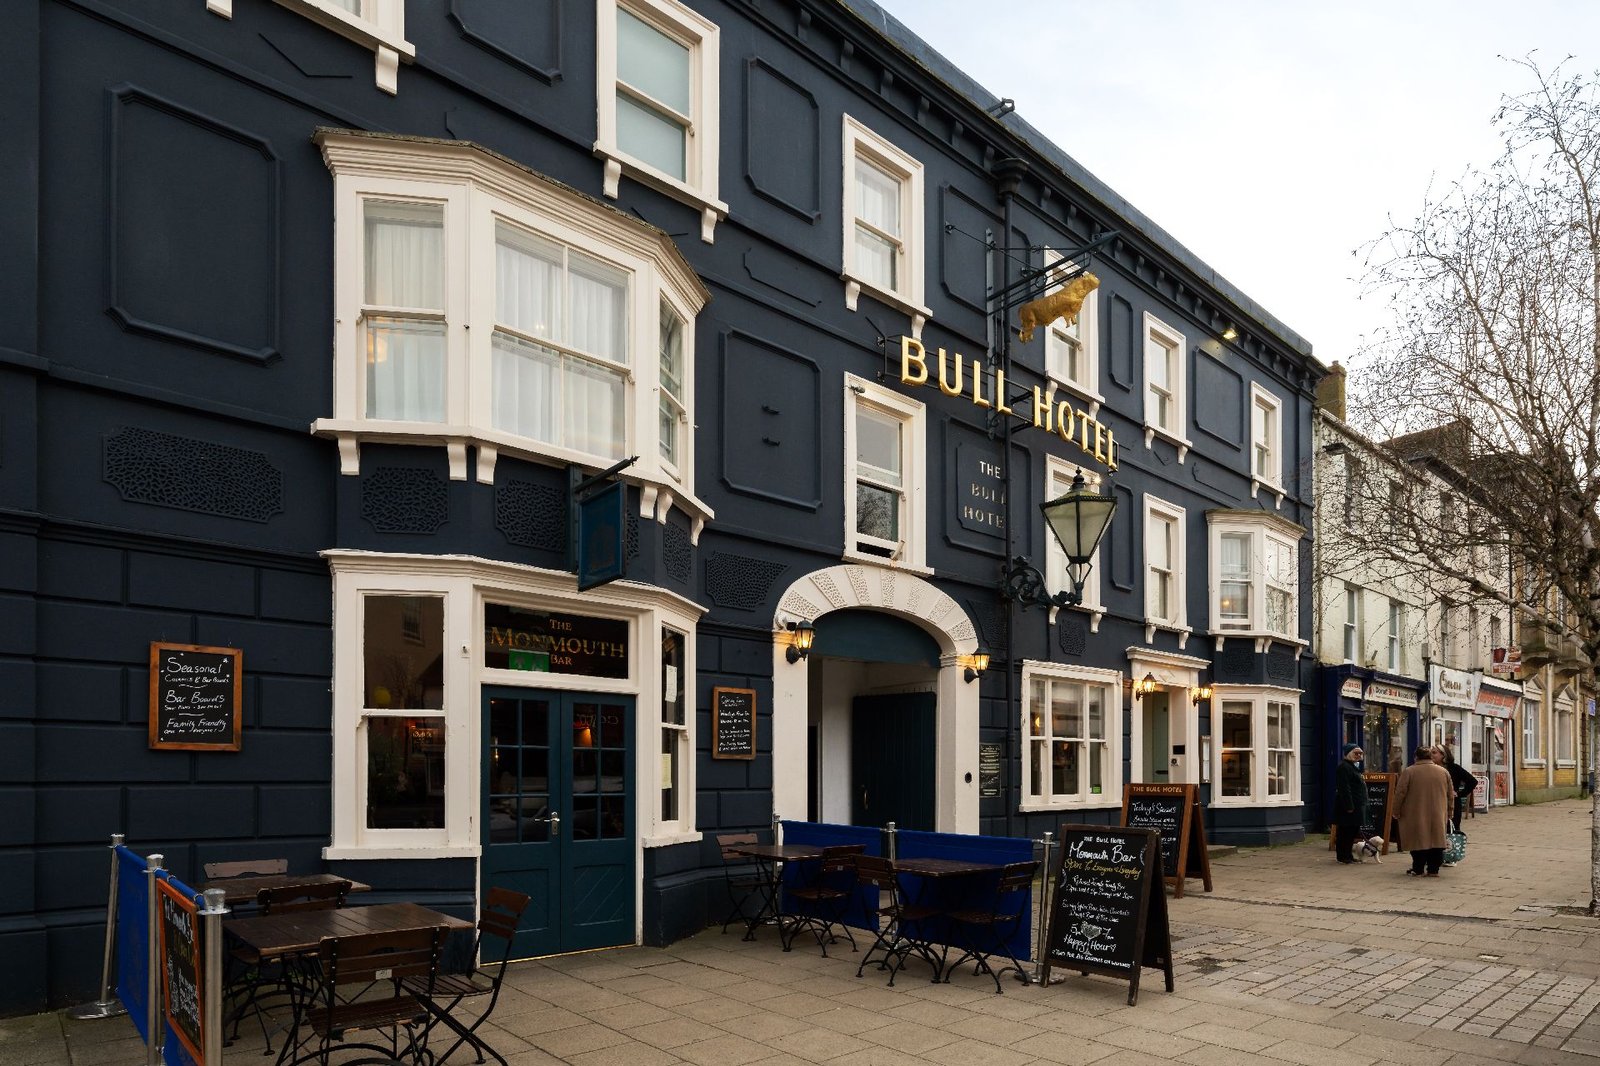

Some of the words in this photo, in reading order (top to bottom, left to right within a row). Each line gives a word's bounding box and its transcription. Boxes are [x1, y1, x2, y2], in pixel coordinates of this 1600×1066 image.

[902, 335, 1012, 415] BULL
[1033, 385, 1118, 472] HOTEL
[979, 460, 1001, 479] THE
[964, 505, 1005, 528] HOTE
[549, 619, 572, 631] THE
[490, 626, 625, 658] MONMOUTH
[167, 656, 222, 674] Seasonal
[550, 654, 572, 666] BAR
[166, 689, 187, 703] Bar
[191, 691, 225, 704] Boards
[167, 718, 195, 732] Family
[198, 718, 227, 732] Friendly
[1111, 845, 1136, 864] Bar
[1064, 934, 1087, 952] Happy
[1090, 940, 1110, 951] Hour
